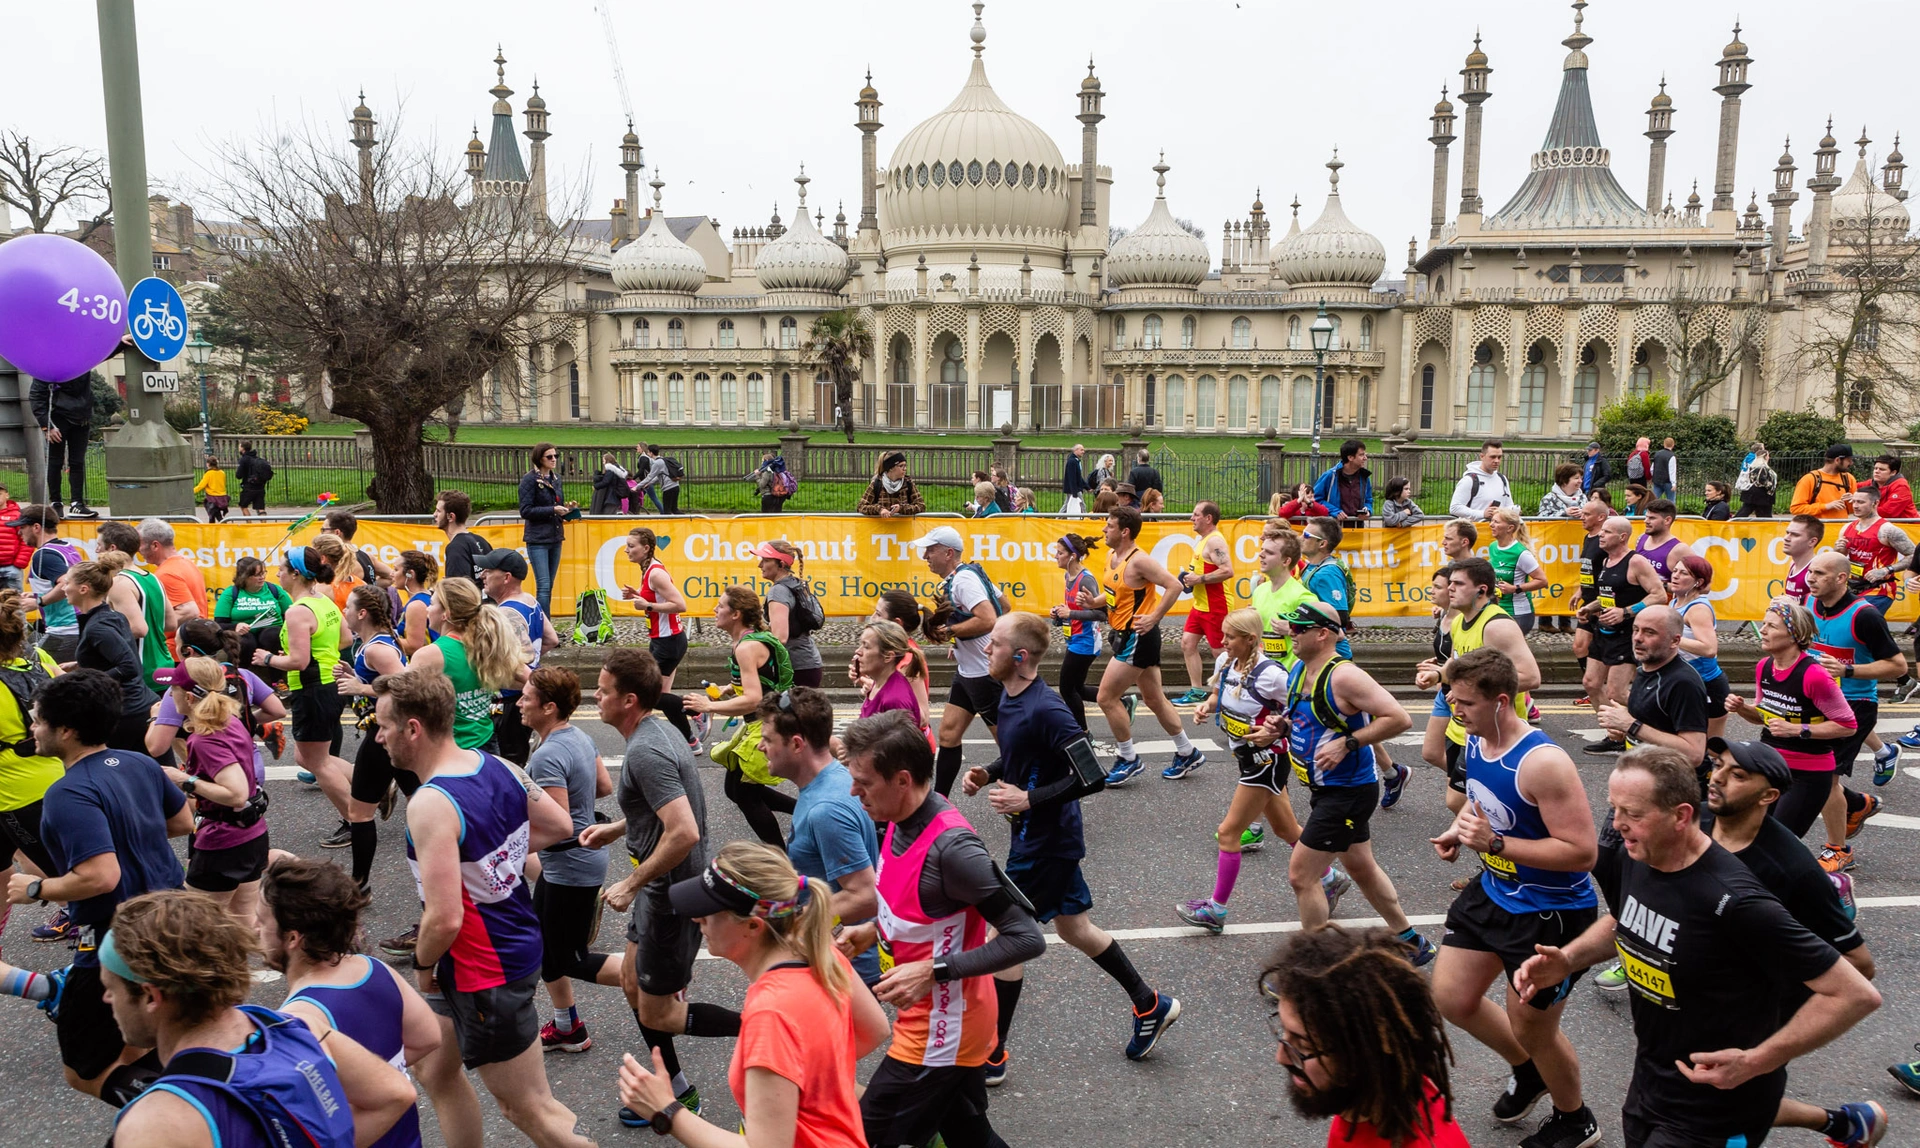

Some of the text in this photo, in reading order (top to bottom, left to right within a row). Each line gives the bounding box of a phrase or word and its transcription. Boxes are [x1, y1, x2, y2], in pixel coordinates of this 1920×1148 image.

[57, 287, 122, 325] 4:30
[146, 375, 176, 390] Only
[684, 534, 1058, 562] Chenut Tr Hous
[684, 575, 827, 599] Childr's
[941, 924, 958, 957] brea
[1620, 894, 1680, 954] DAVE
[1629, 964, 1665, 992] 44147
[938, 980, 951, 1015] ancer
[294, 1059, 340, 1119] CAMELBAK
